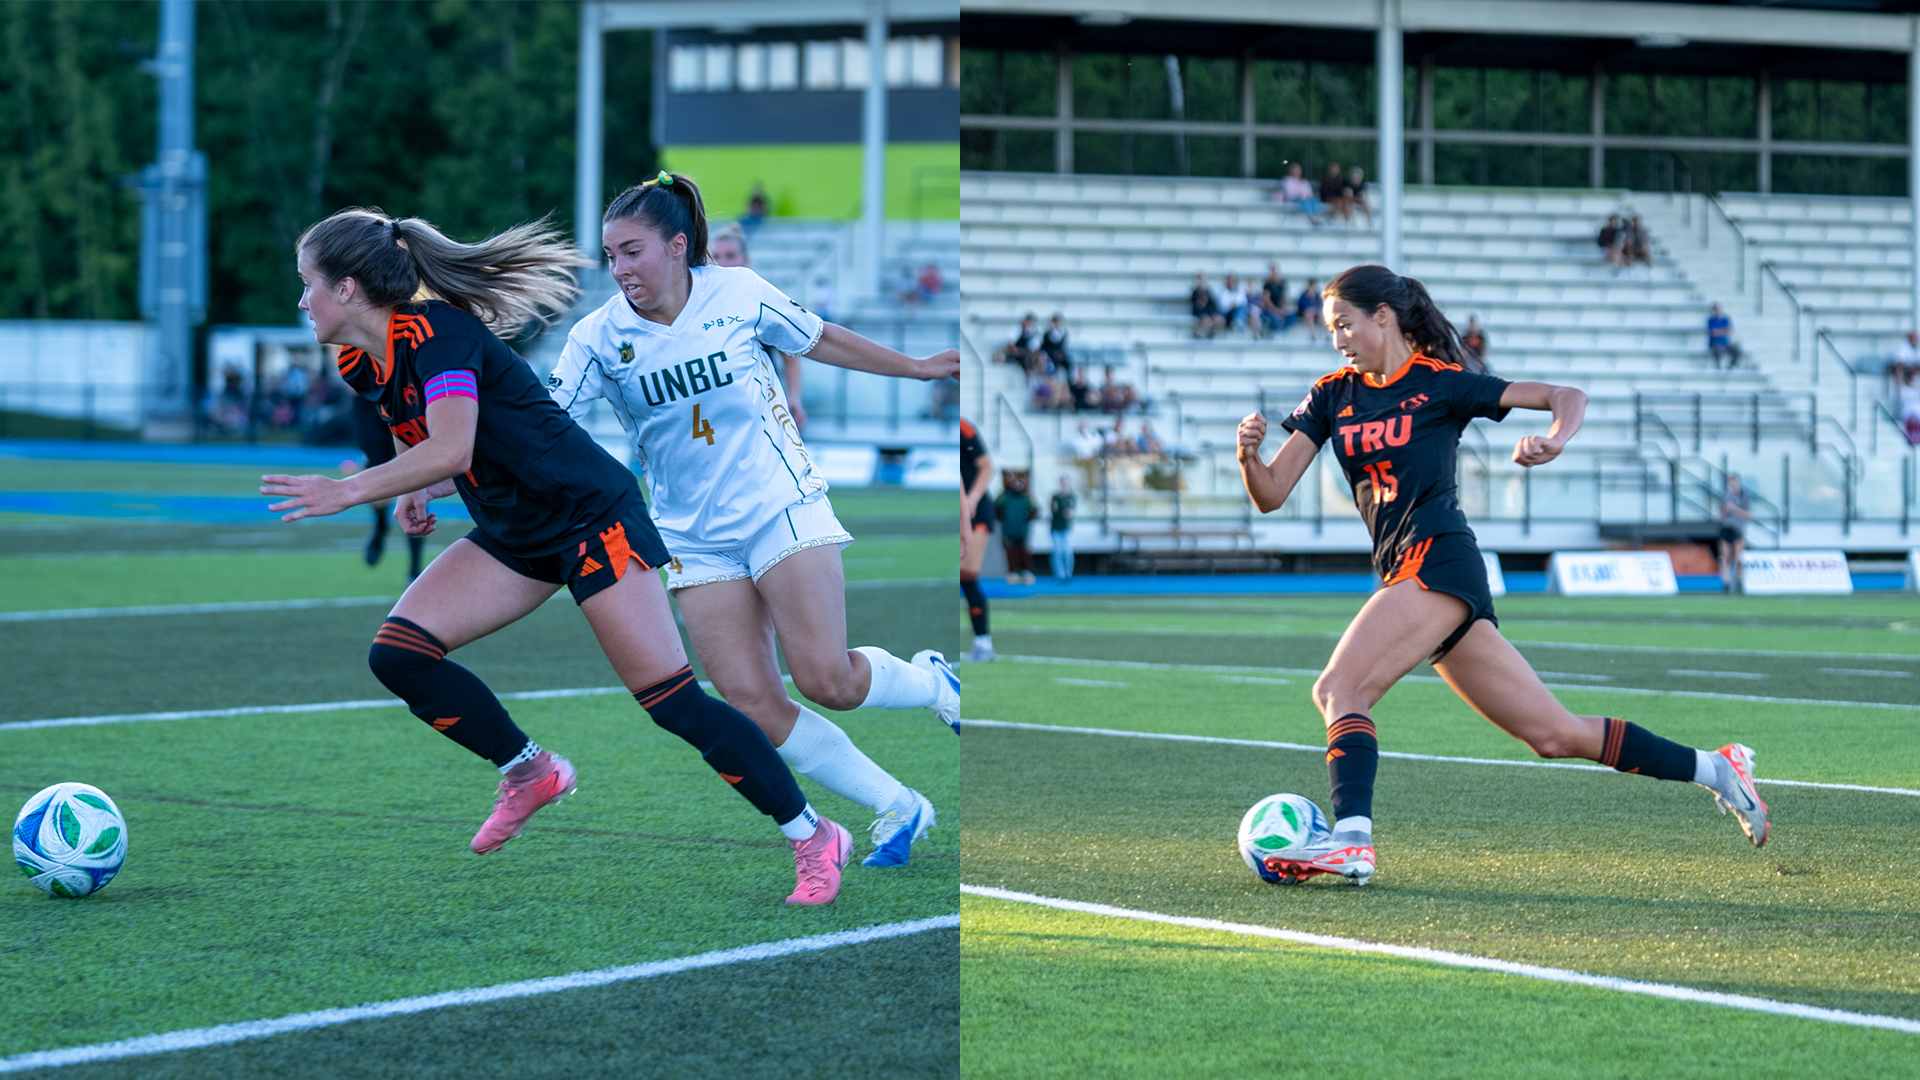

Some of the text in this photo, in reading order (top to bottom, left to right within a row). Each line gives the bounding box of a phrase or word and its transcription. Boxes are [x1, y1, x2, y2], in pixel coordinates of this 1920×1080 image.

[640, 351, 733, 406] UNBC
[693, 403, 715, 446] 4
[1339, 414, 1412, 456] TRU
[1363, 460, 1399, 504] 15
[669, 555, 683, 574] 4
